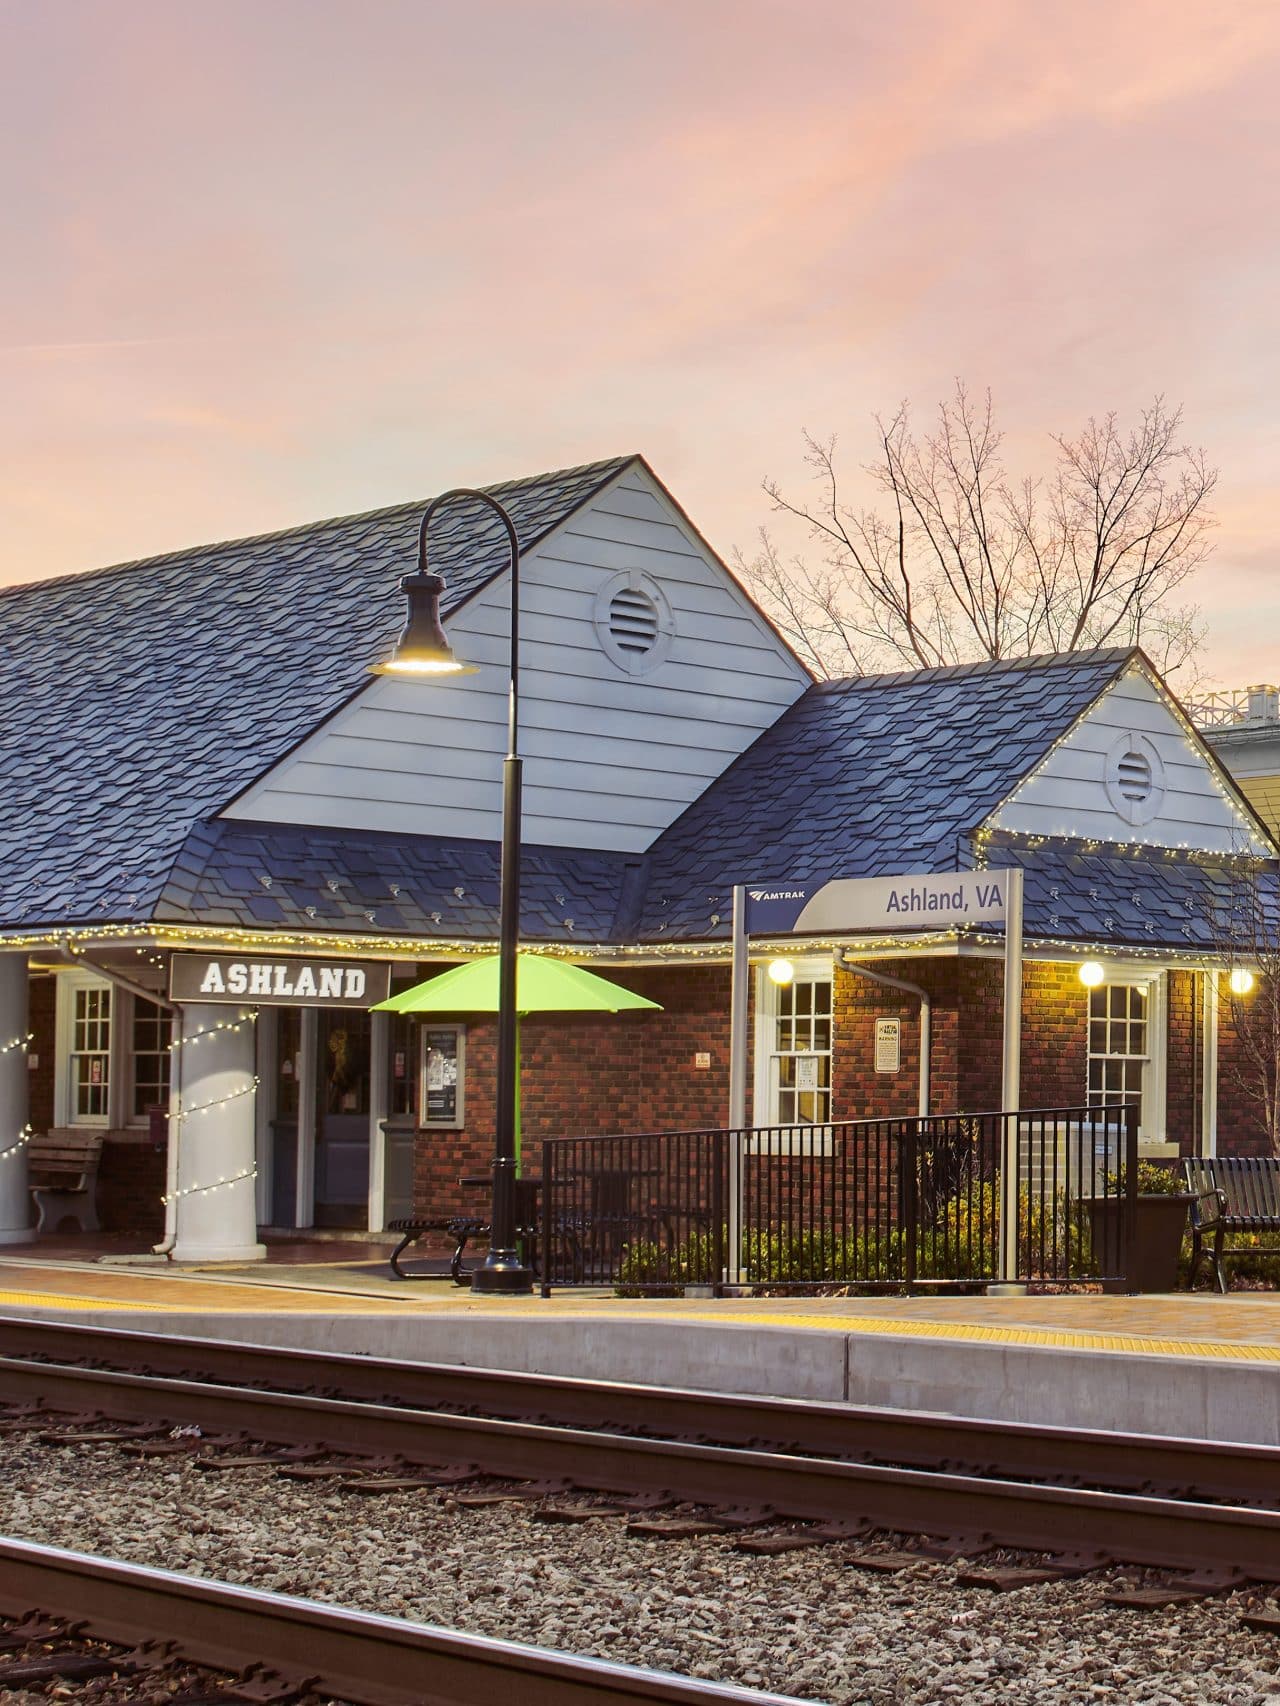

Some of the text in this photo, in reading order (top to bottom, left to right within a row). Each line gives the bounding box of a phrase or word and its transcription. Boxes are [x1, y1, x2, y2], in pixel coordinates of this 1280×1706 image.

[764, 891, 805, 900] AMTRAK
[886, 884, 1003, 912] Ashland, VA
[200, 962, 366, 998] ASHLAND
